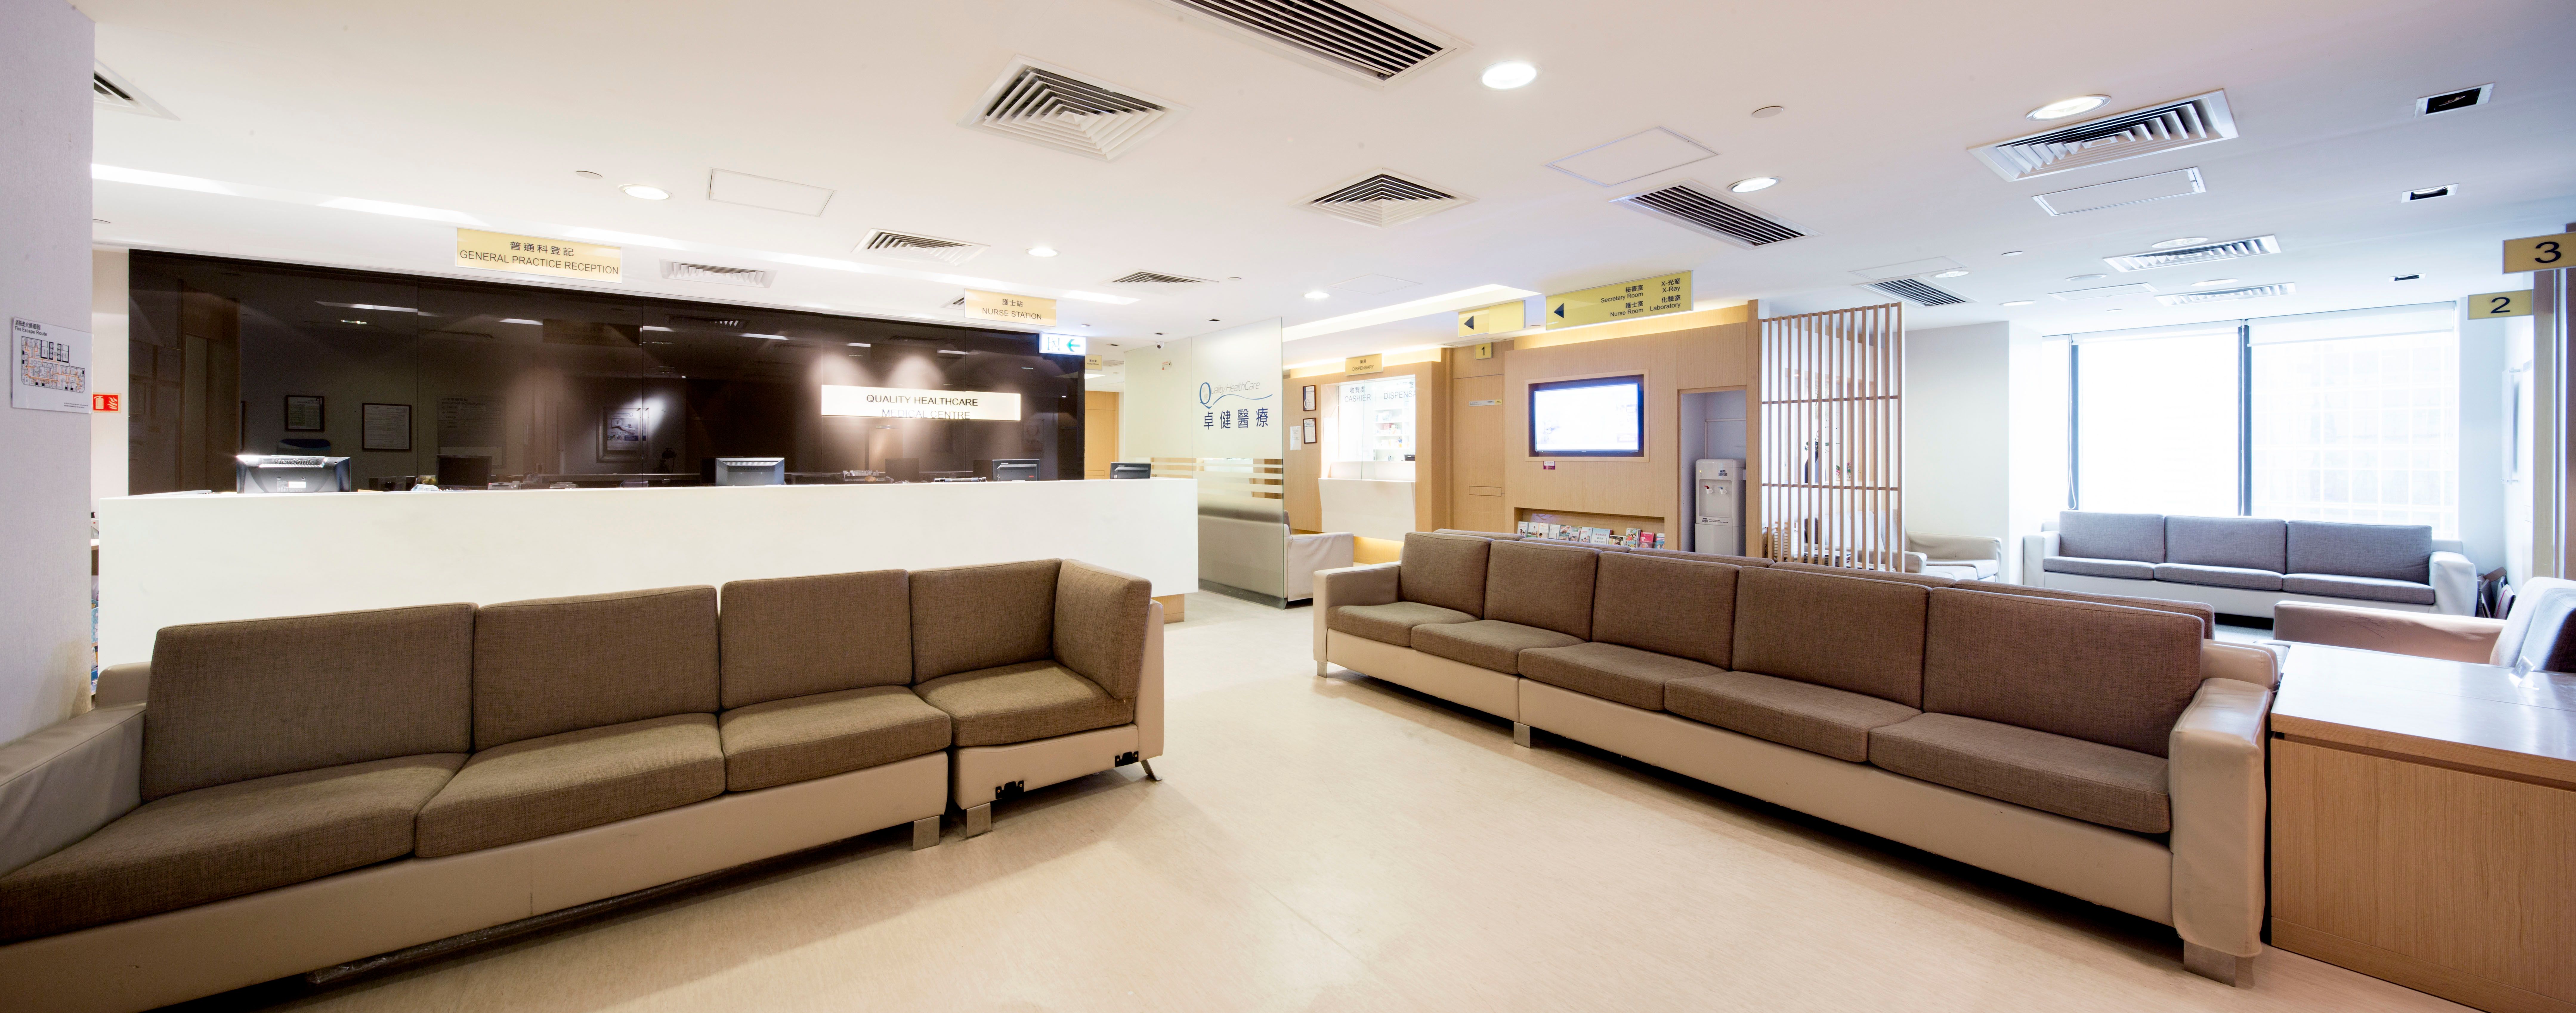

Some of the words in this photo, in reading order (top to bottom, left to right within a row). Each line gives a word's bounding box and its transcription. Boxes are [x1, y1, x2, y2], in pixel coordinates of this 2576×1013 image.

[510, 241, 574, 257] 普通科登記
[2535, 241, 2561, 263] 3
[460, 250, 509, 263] GENERAL
[512, 256, 562, 269] PRACTICE
[565, 261, 618, 274] RECEPTION
[1661, 278, 1681, 286] X-光室
[1625, 285, 1643, 293] 秘書室
[1002, 298, 1023, 307] 護士站
[1601, 295, 1625, 303] Secretary
[1662, 295, 1681, 303] 化驗室
[1625, 301, 1643, 309] 護士室
[1650, 303, 1681, 311] Laboratory
[2490, 297, 2510, 314] 2
[982, 308, 1009, 316] NURSE
[1011, 311, 1042, 320] STATION
[1481, 346, 1485, 356] 1
[866, 394, 911, 404] QUALITY
[914, 396, 978, 406] HEALTHCARE
[1345, 394, 1371, 402] CASHIER
[882, 409, 927, 418] MEDICAL
[930, 410, 971, 419] CENTRE
[1203, 407, 1268, 430] 卓健醫療
